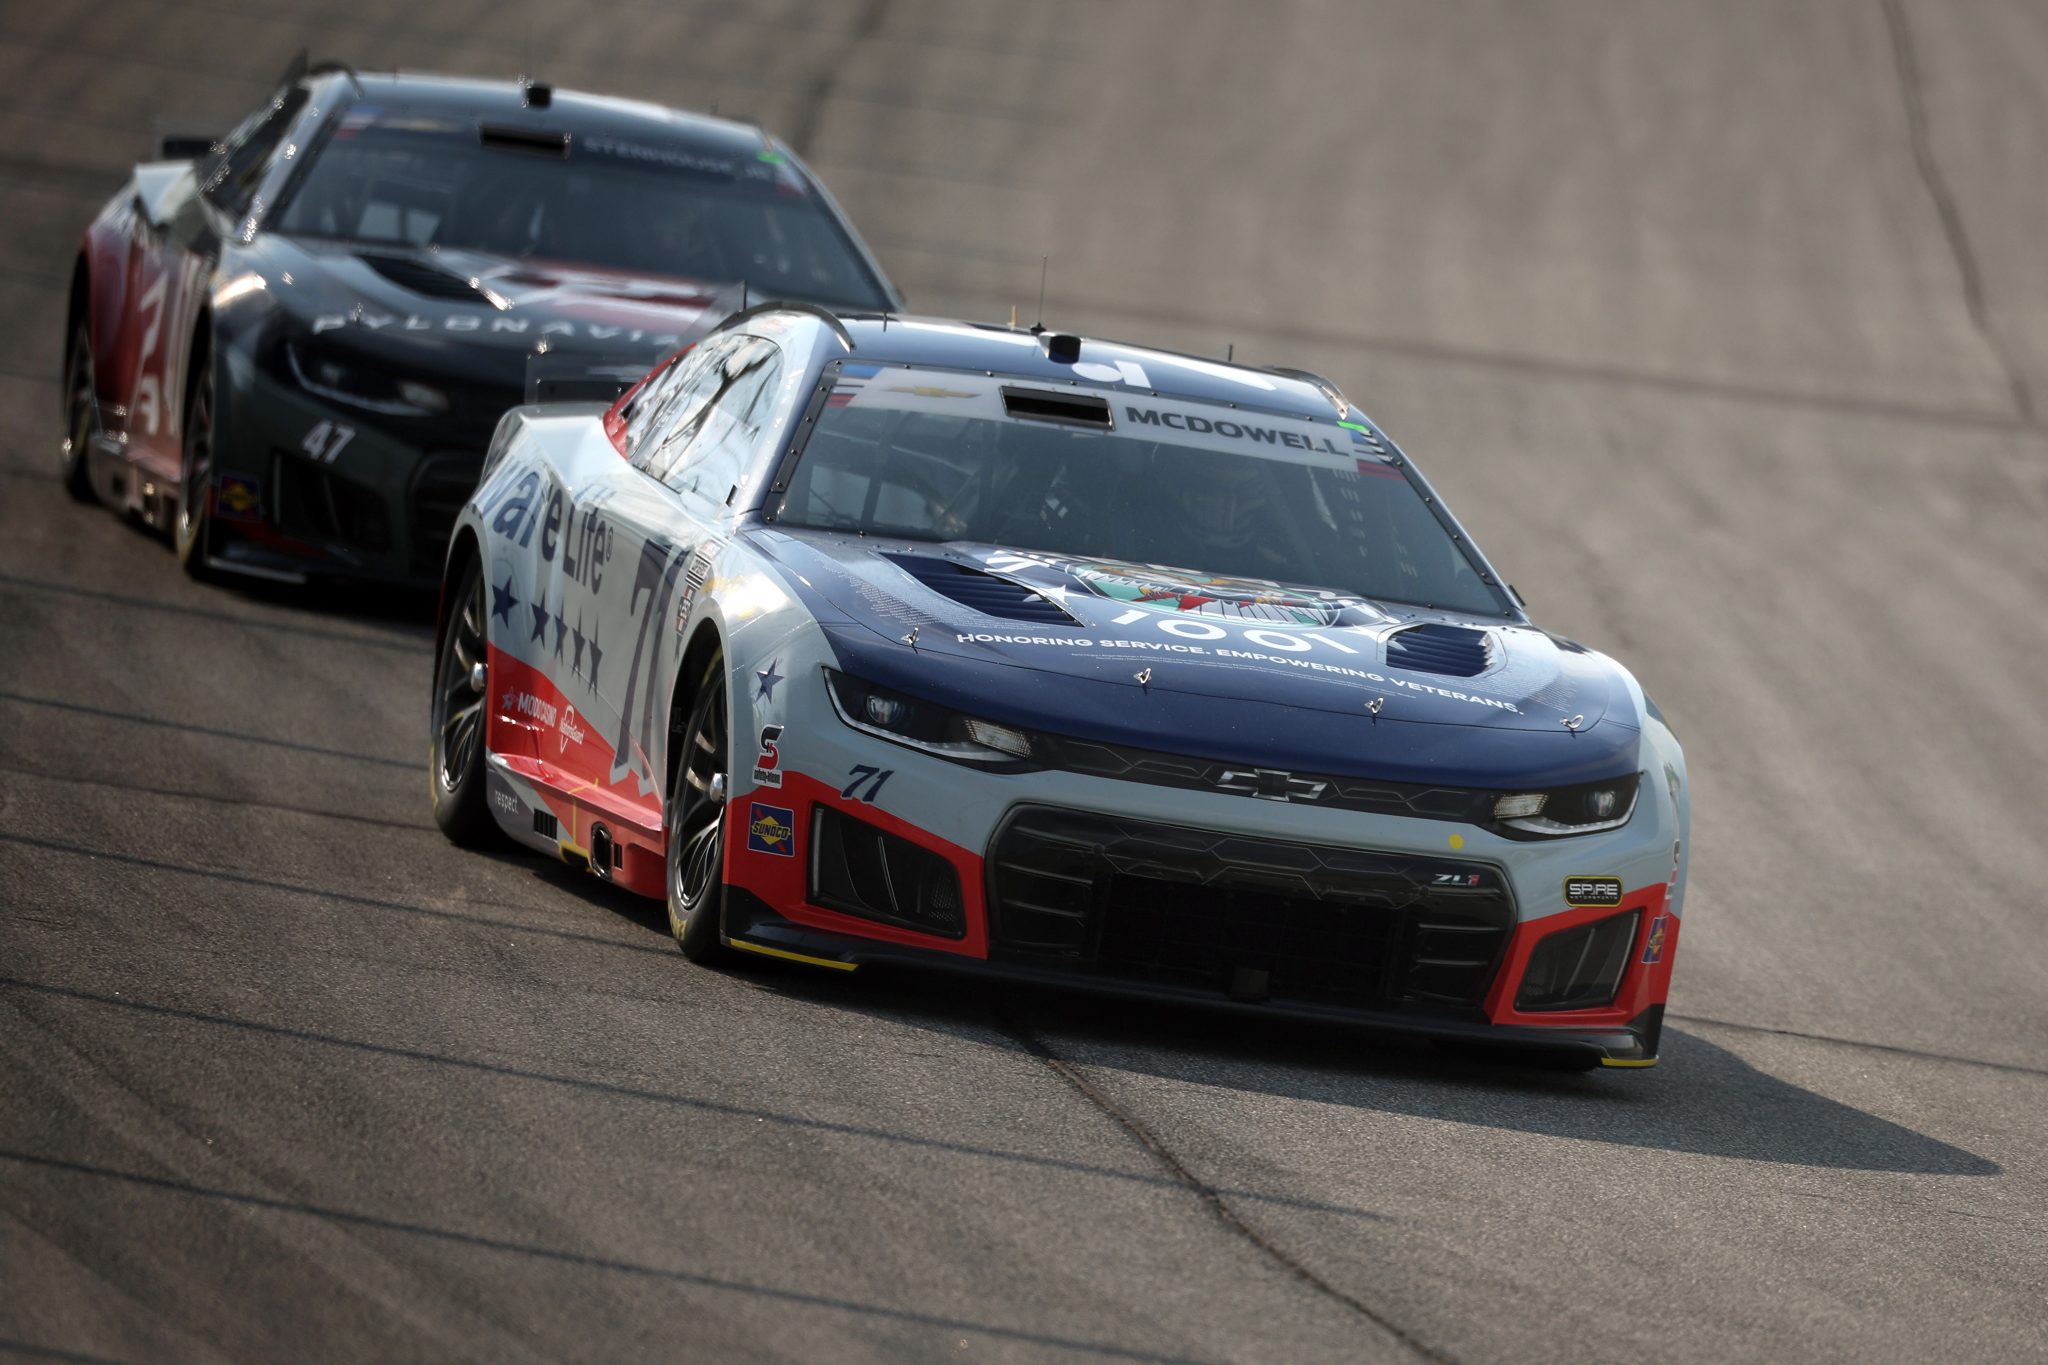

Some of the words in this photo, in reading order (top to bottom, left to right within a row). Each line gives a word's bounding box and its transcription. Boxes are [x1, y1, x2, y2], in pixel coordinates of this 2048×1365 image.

[304, 420, 356, 464] 47
[1126, 406, 1350, 456] MCDOWELL
[613, 537, 692, 780] 71
[957, 633, 1094, 647] HONORING
[1099, 639, 1211, 655] SERVICE.
[1216, 648, 1385, 682] EMPOWERING
[1390, 677, 1525, 715] VETERANS.
[841, 764, 895, 802] 71
[752, 822, 790, 839] SUNOCO
[1431, 873, 1481, 887] ZL1
[1569, 883, 1618, 896] SPIRE
